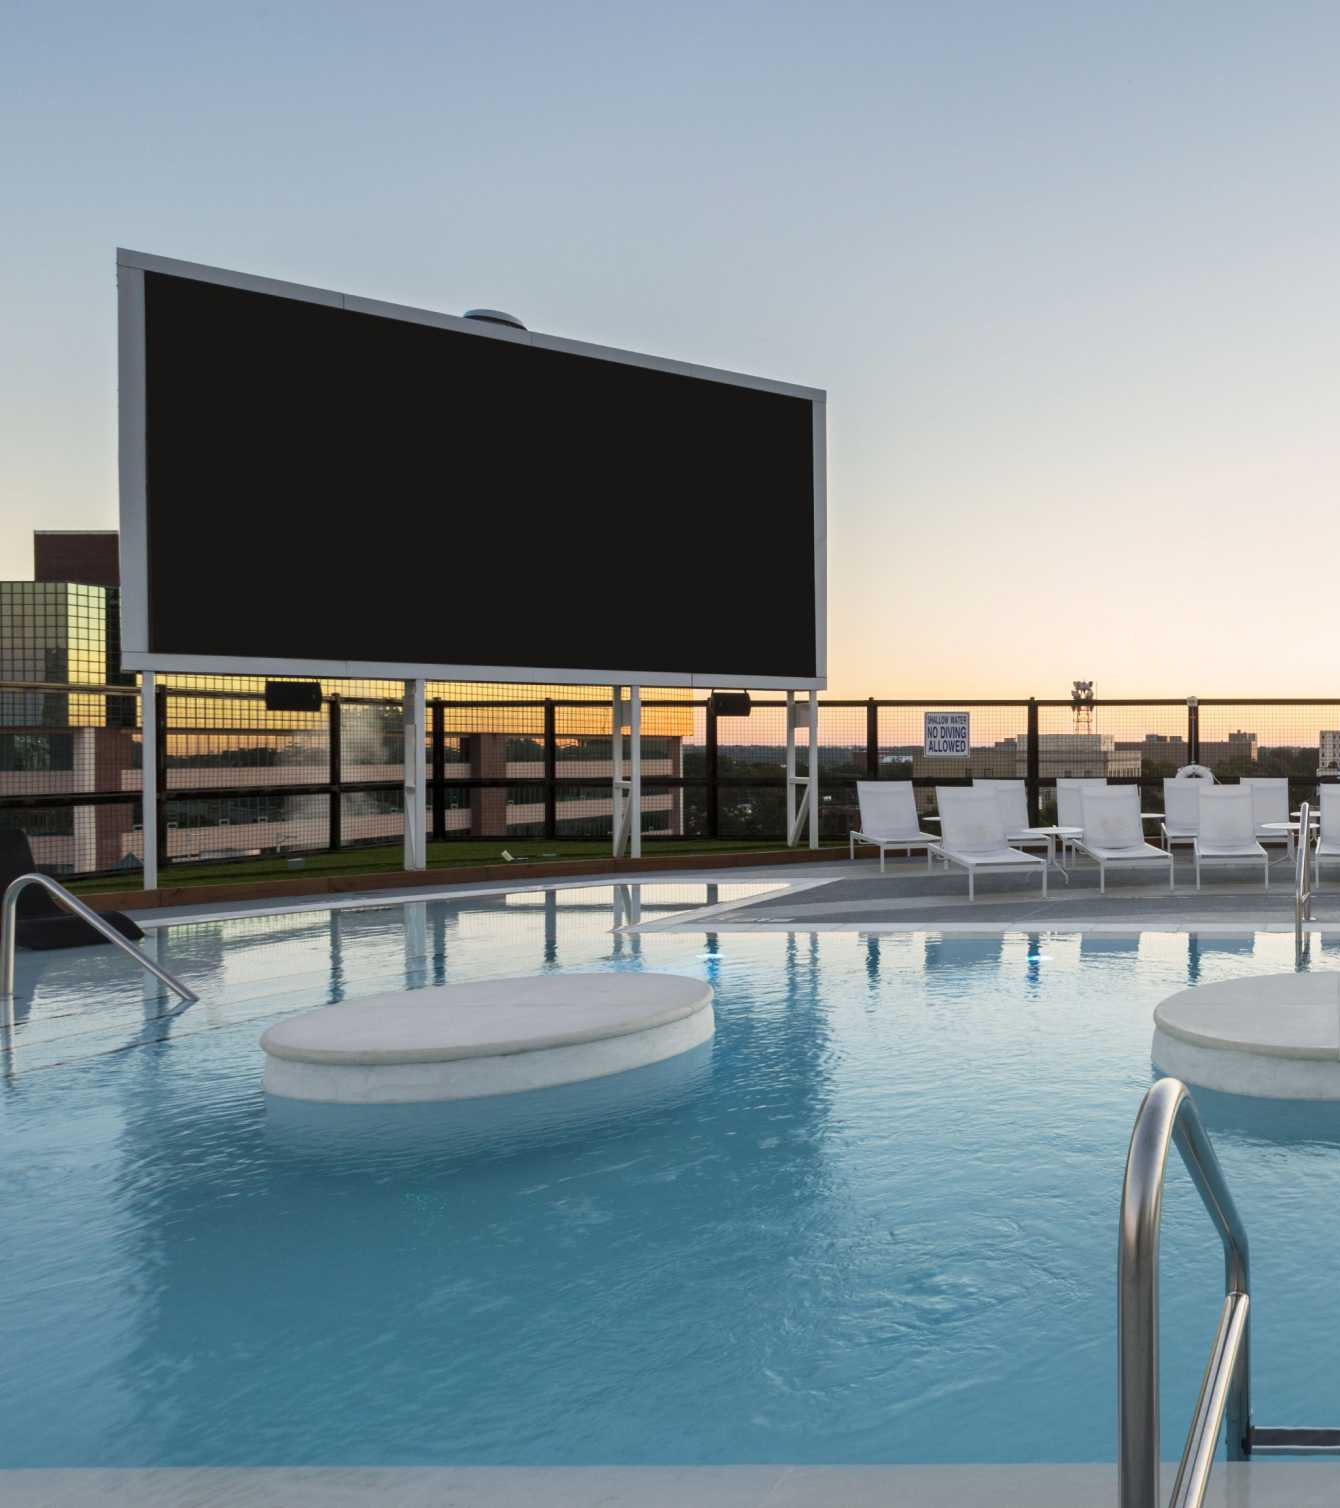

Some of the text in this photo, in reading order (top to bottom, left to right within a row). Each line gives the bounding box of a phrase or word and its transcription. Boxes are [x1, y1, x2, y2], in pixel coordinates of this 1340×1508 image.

[928, 726, 967, 739] NO DIVING
[928, 740, 966, 752] ALLOWED
